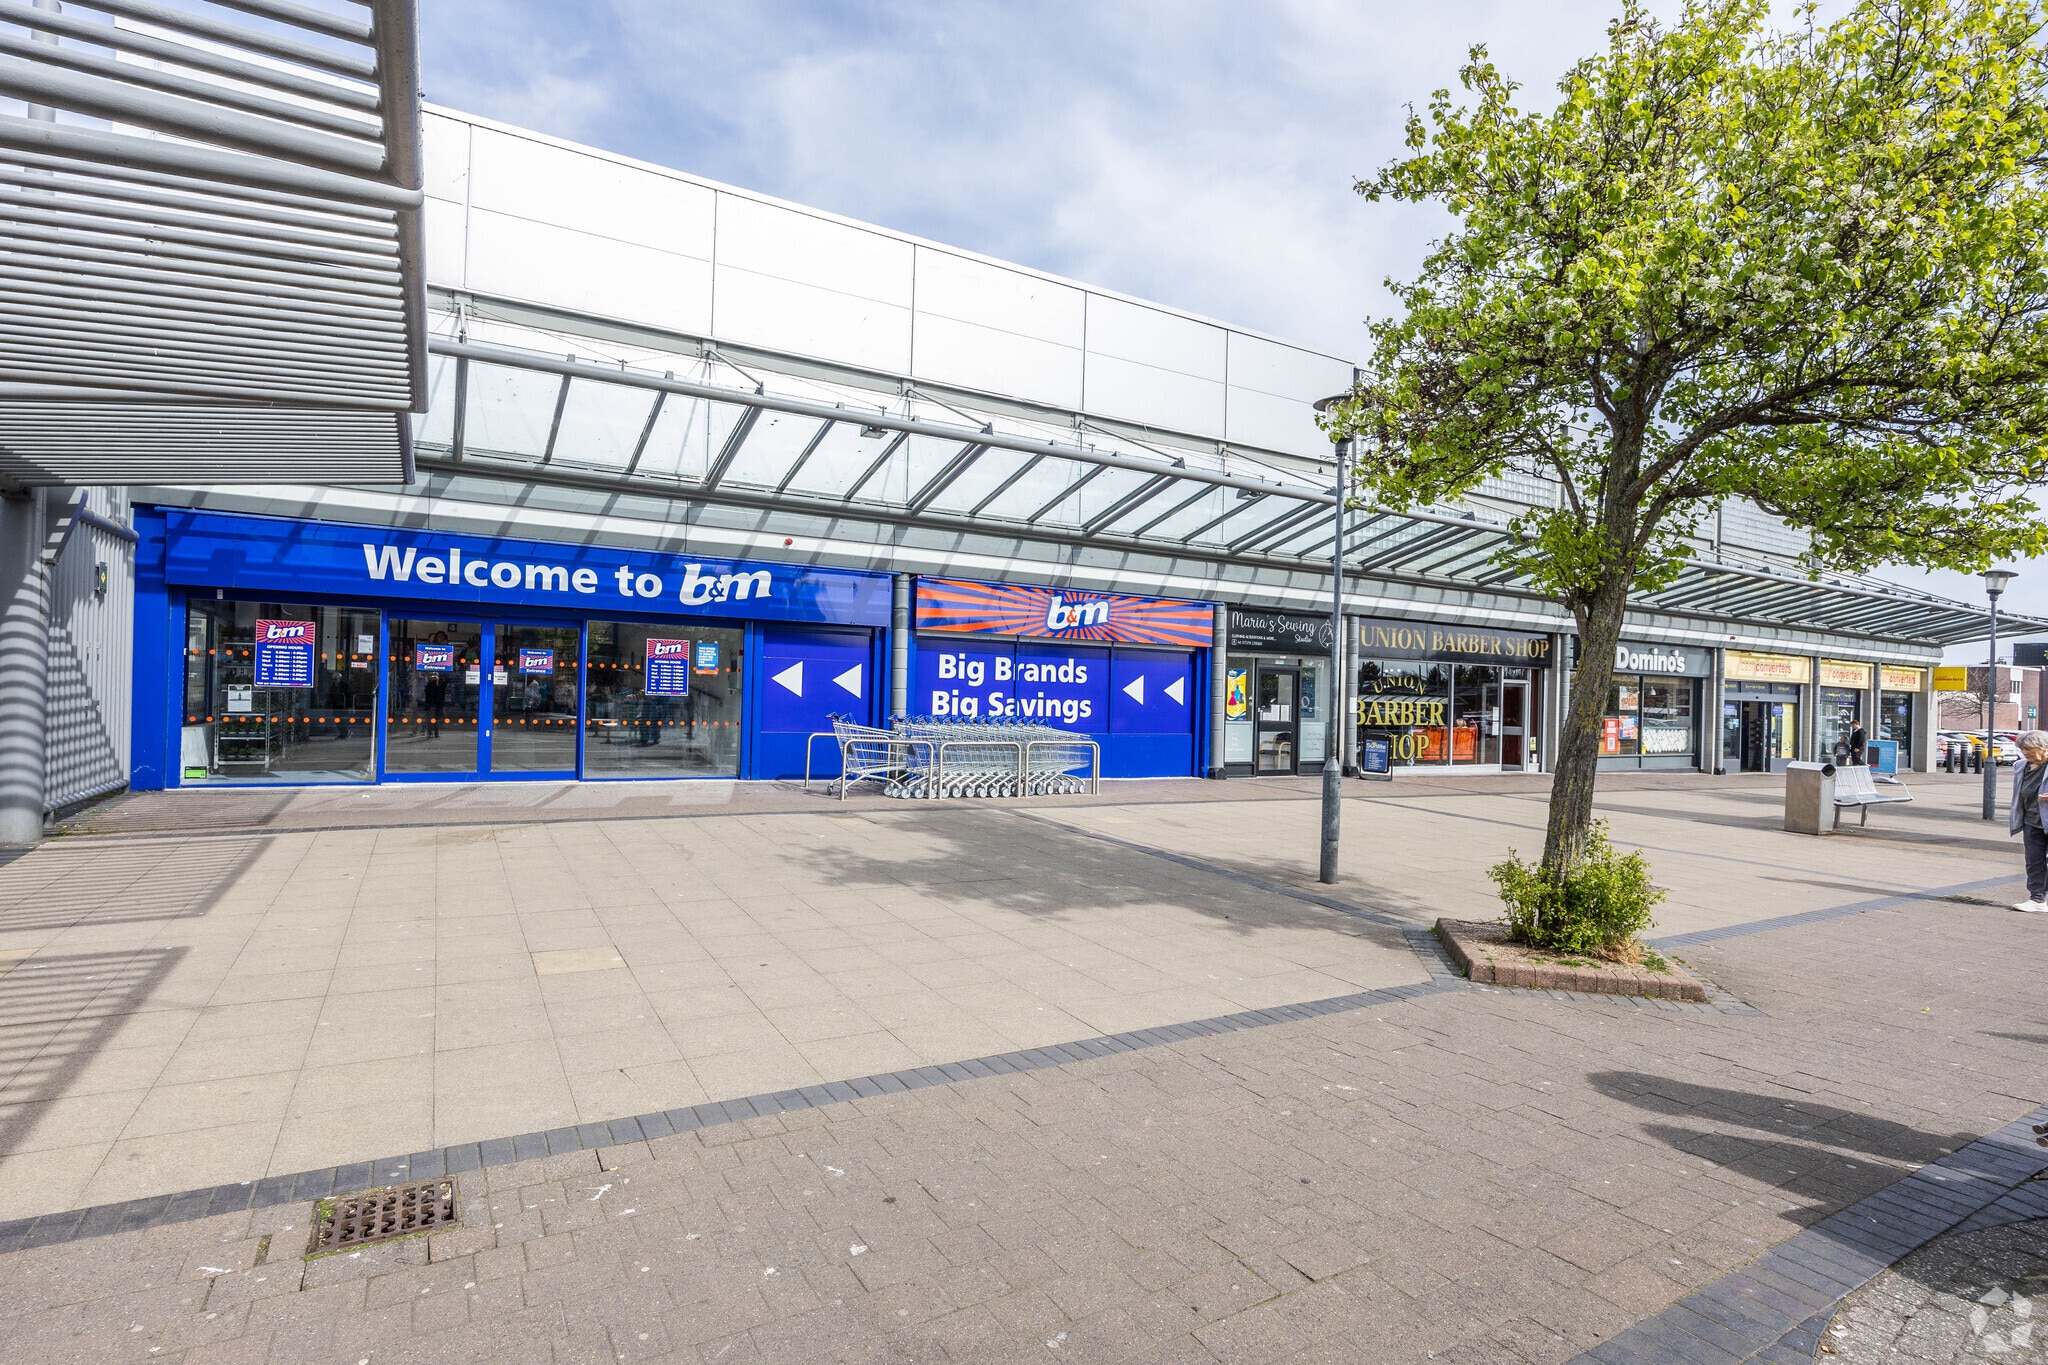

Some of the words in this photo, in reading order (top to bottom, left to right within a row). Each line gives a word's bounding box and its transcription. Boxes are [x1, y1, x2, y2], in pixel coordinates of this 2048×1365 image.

[363, 543, 597, 594] Welcome
[614, 565, 663, 598] to
[679, 563, 772, 606] b&m
[1047, 595, 1109, 630] b&m
[1231, 611, 1276, 632] Maria's
[1277, 615, 1317, 637] Sewing
[1360, 624, 1427, 650] UNION
[1431, 631, 1502, 655] BARBER
[1505, 637, 1550, 659] SHOP
[938, 653, 985, 687] Big
[994, 656, 1088, 684] Brands
[1616, 646, 1686, 673] Domino's
[1372, 673, 1427, 695] UNION
[1889, 674, 1916, 684] converters
[931, 689, 979, 719] Big
[988, 691, 1092, 724] Savings
